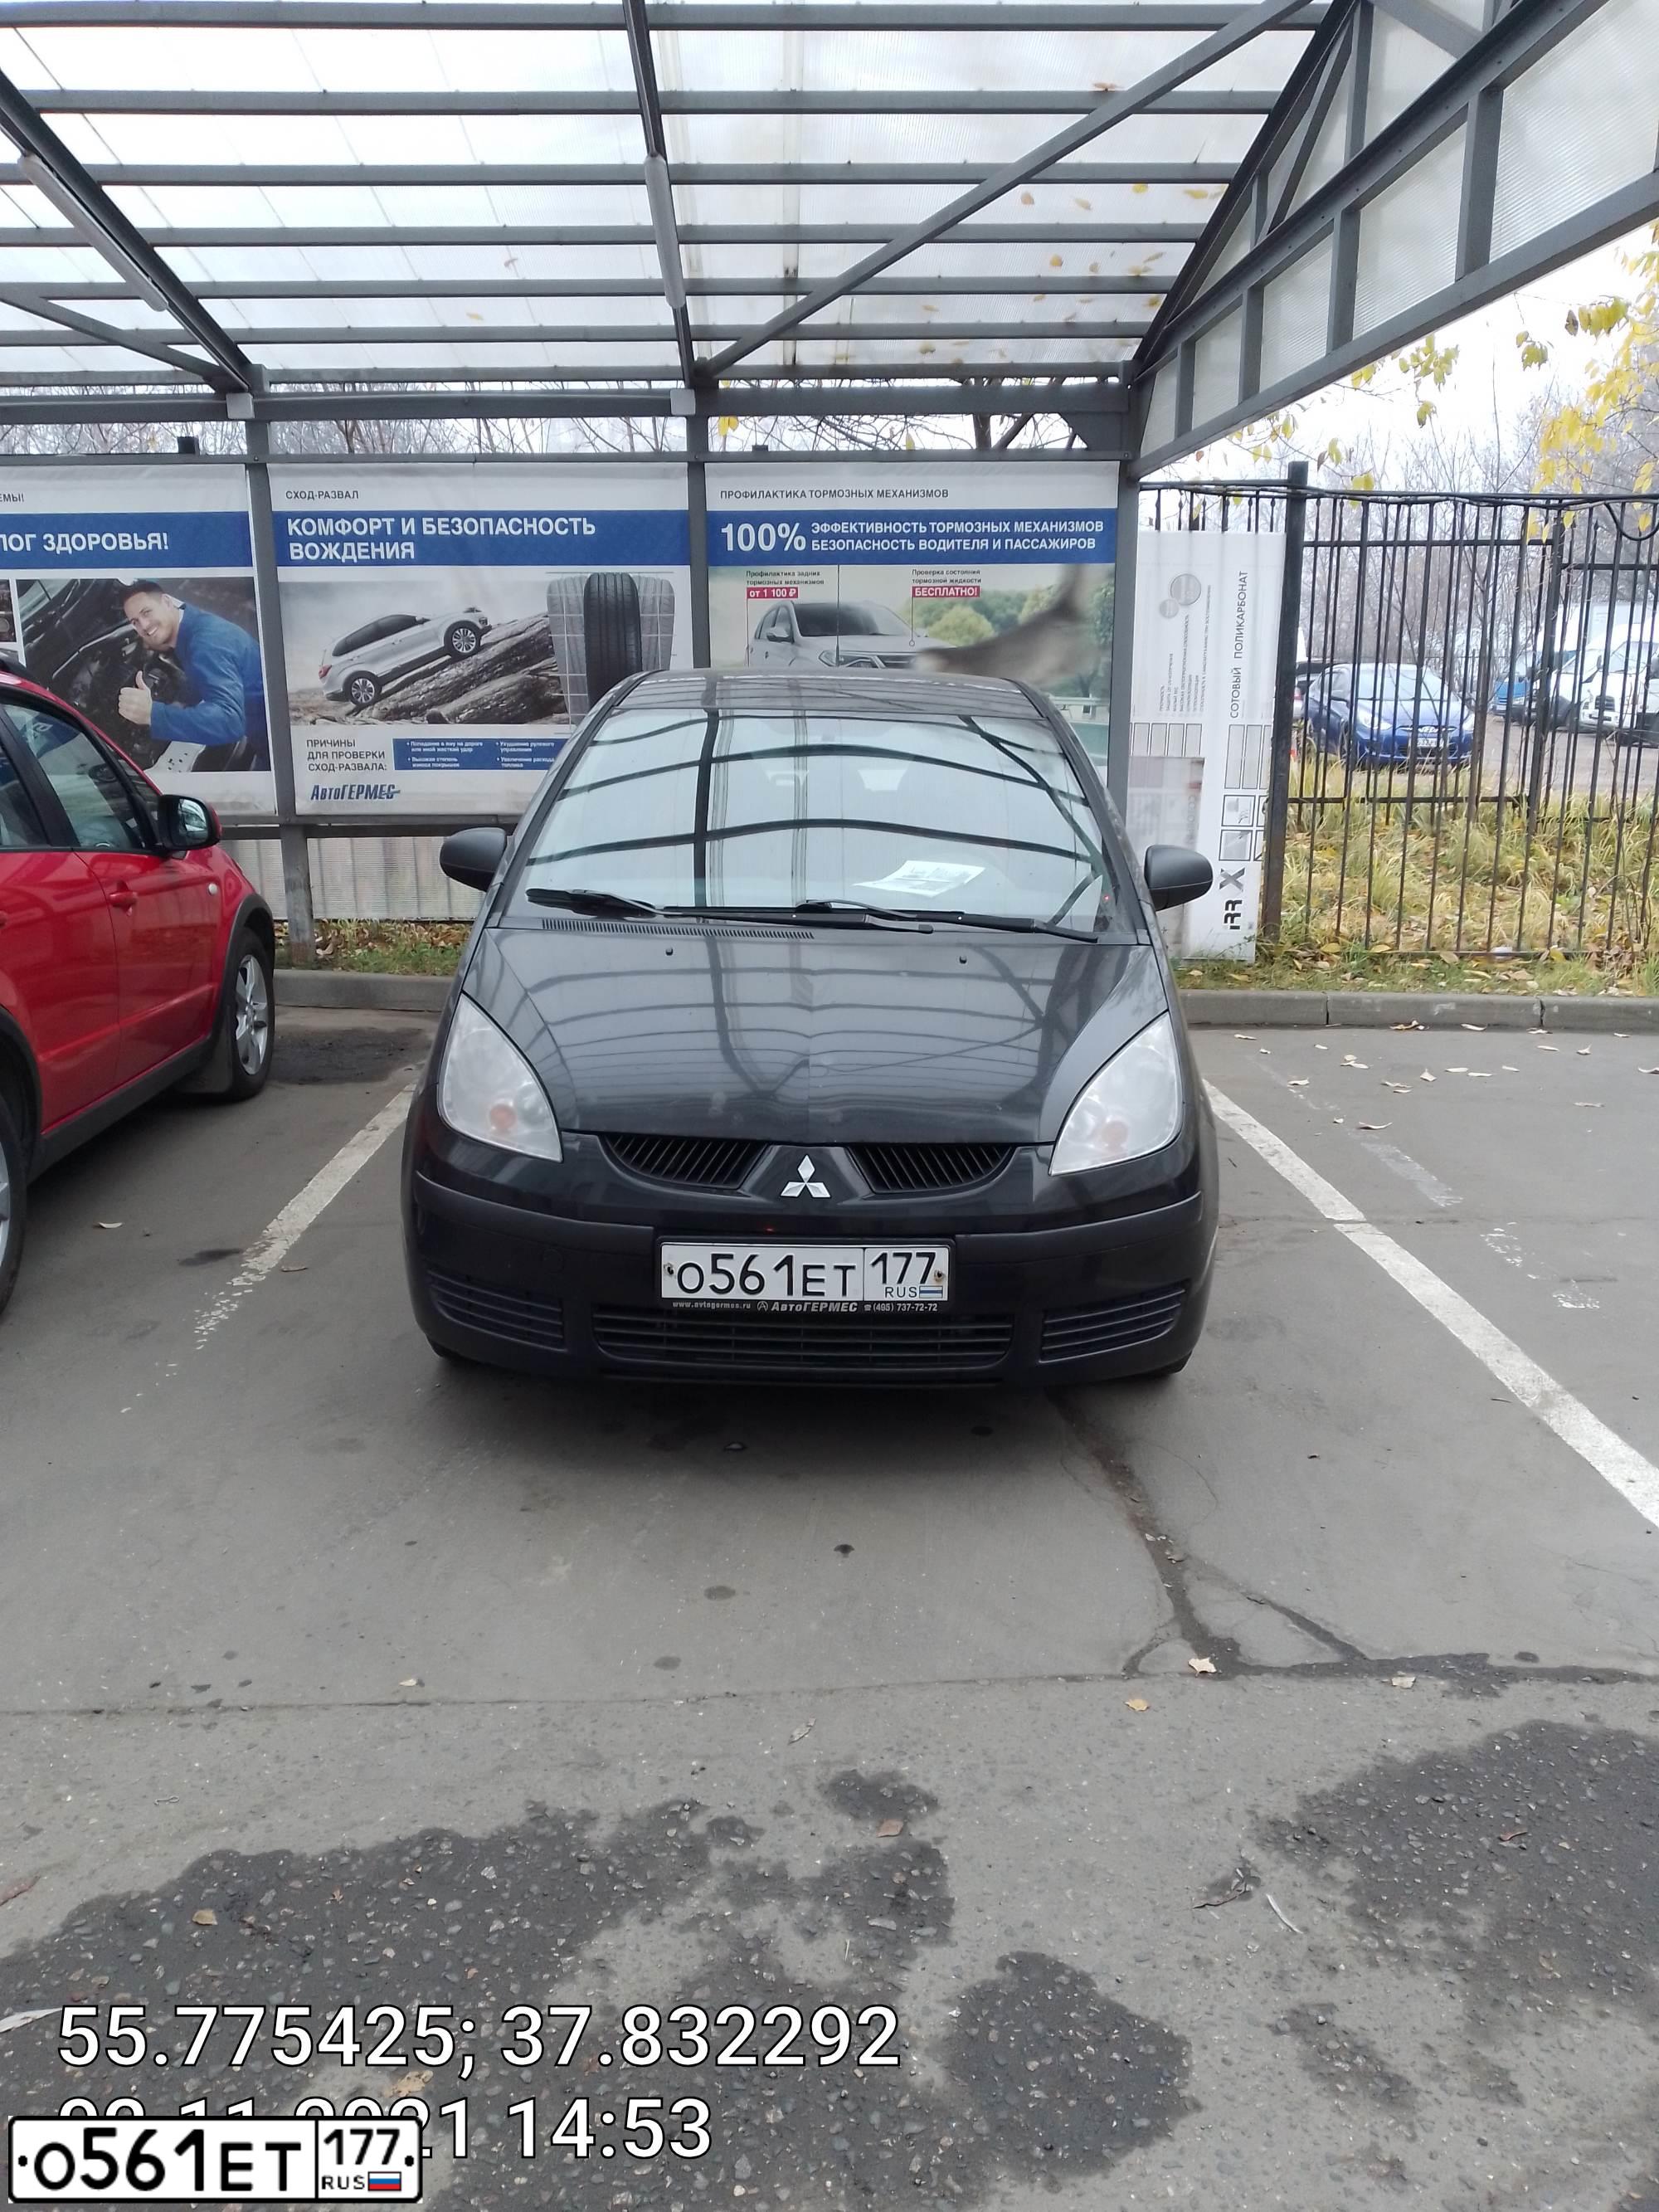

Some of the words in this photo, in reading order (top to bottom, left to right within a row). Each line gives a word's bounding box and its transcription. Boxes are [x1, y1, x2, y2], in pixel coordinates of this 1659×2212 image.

[285, 490, 359, 500] СХОД-РАЗВАЛ
[720, 490, 807, 499] ПРОФИЛАКТИКА
[809, 489, 873, 499] ТОРМОЗНЫХ
[877, 489, 949, 498] МЕХАНИЗМОВ
[287, 517, 395, 536] КОМФОРТ
[401, 517, 416, 536] И
[421, 517, 596, 535] БЕЗОПАСНОСТЬ
[811, 522, 927, 534] ЭФФЕКТИВНОСТЬ
[929, 521, 1010, 534] ТОРМОЗНЫХ
[1014, 520, 1104, 533] МЕХАНИЗМОВ
[42, 532, 169, 555] ЗДОРОВЬЯ!
[721, 523, 806, 552] 100%
[811, 539, 916, 551] БЕЗОПАСНОСТЬ
[919, 538, 989, 552] ВОДИТЕЛЯ
[993, 538, 1002, 550] И
[1005, 538, 1096, 550] ПАССАЖИРОВ
[289, 542, 415, 563] ВОЖДЕНИЯ
[915, 587, 977, 597] БЕСПЛАТНО!
[1233, 571, 1248, 659] ПОЛИКАРБОНАТ
[1230, 667, 1242, 719] СОТОВЫЙ
[306, 739, 356, 748] ПРИЧИНЫ
[307, 751, 328, 760] ДЛЯ
[332, 751, 385, 759] ПРОВЕРКИ
[308, 763, 387, 772] СХОД-РАЗВАЛА:
[310, 784, 399, 801] АвтоГЕРМЕС
[870, 1252, 937, 1285] 177
[884, 1287, 917, 1298] RUS
[771, 1302, 858, 1312] АвтоГЕРМЕС
[897, 1303, 938, 1312] 737-72-72
